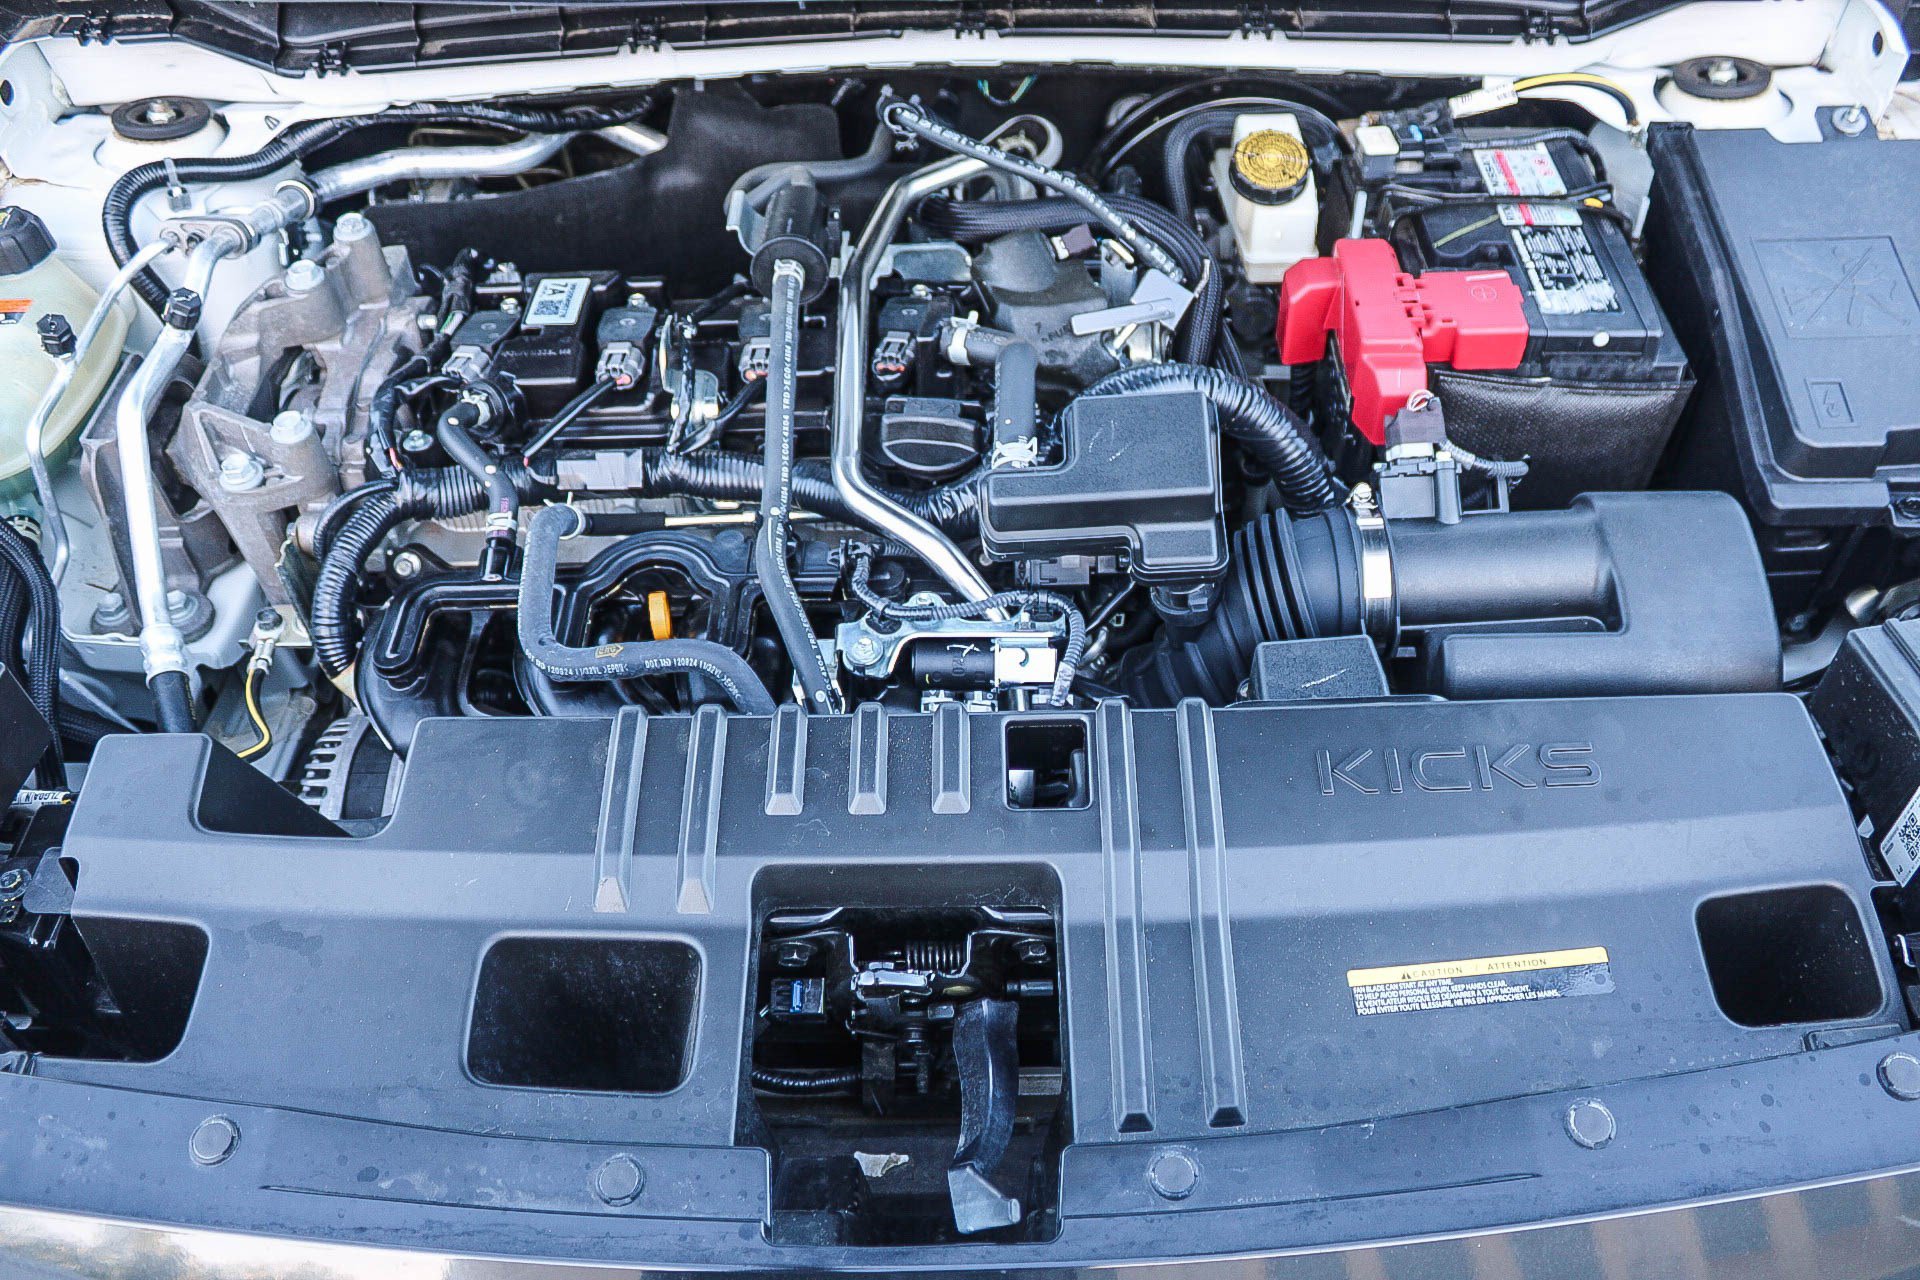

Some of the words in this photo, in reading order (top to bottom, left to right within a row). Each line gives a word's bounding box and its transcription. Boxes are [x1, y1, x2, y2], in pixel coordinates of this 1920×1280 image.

[1315, 743, 1602, 795] KICKS
[1413, 967, 1463, 978] CAUTION
[1487, 959, 1547, 971] ATTENTION
[1353, 986, 1366, 994] FAN
[1366, 985, 1385, 993] BLADE
[1399, 982, 1416, 990] START
[1364, 997, 1406, 1007] VENTILATEUR
[1407, 996, 1430, 1004] RISQUE
[1483, 987, 1499, 995] TOUT
[1500, 985, 1531, 994] MOMENT.
[1400, 989, 1429, 997] PERSONAL
[1451, 984, 1465, 992] KEEP
[1466, 982, 1486, 990] HANDS
[1487, 980, 1508, 988] CLEAR.
[1399, 1003, 1420, 1011] TOUTE
[1464, 997, 1476, 1005] PAS
[1487, 993, 1525, 1003] APPROCHER
[1525, 992, 1537, 1000] LES
[1537, 989, 1560, 998] MAINS.
